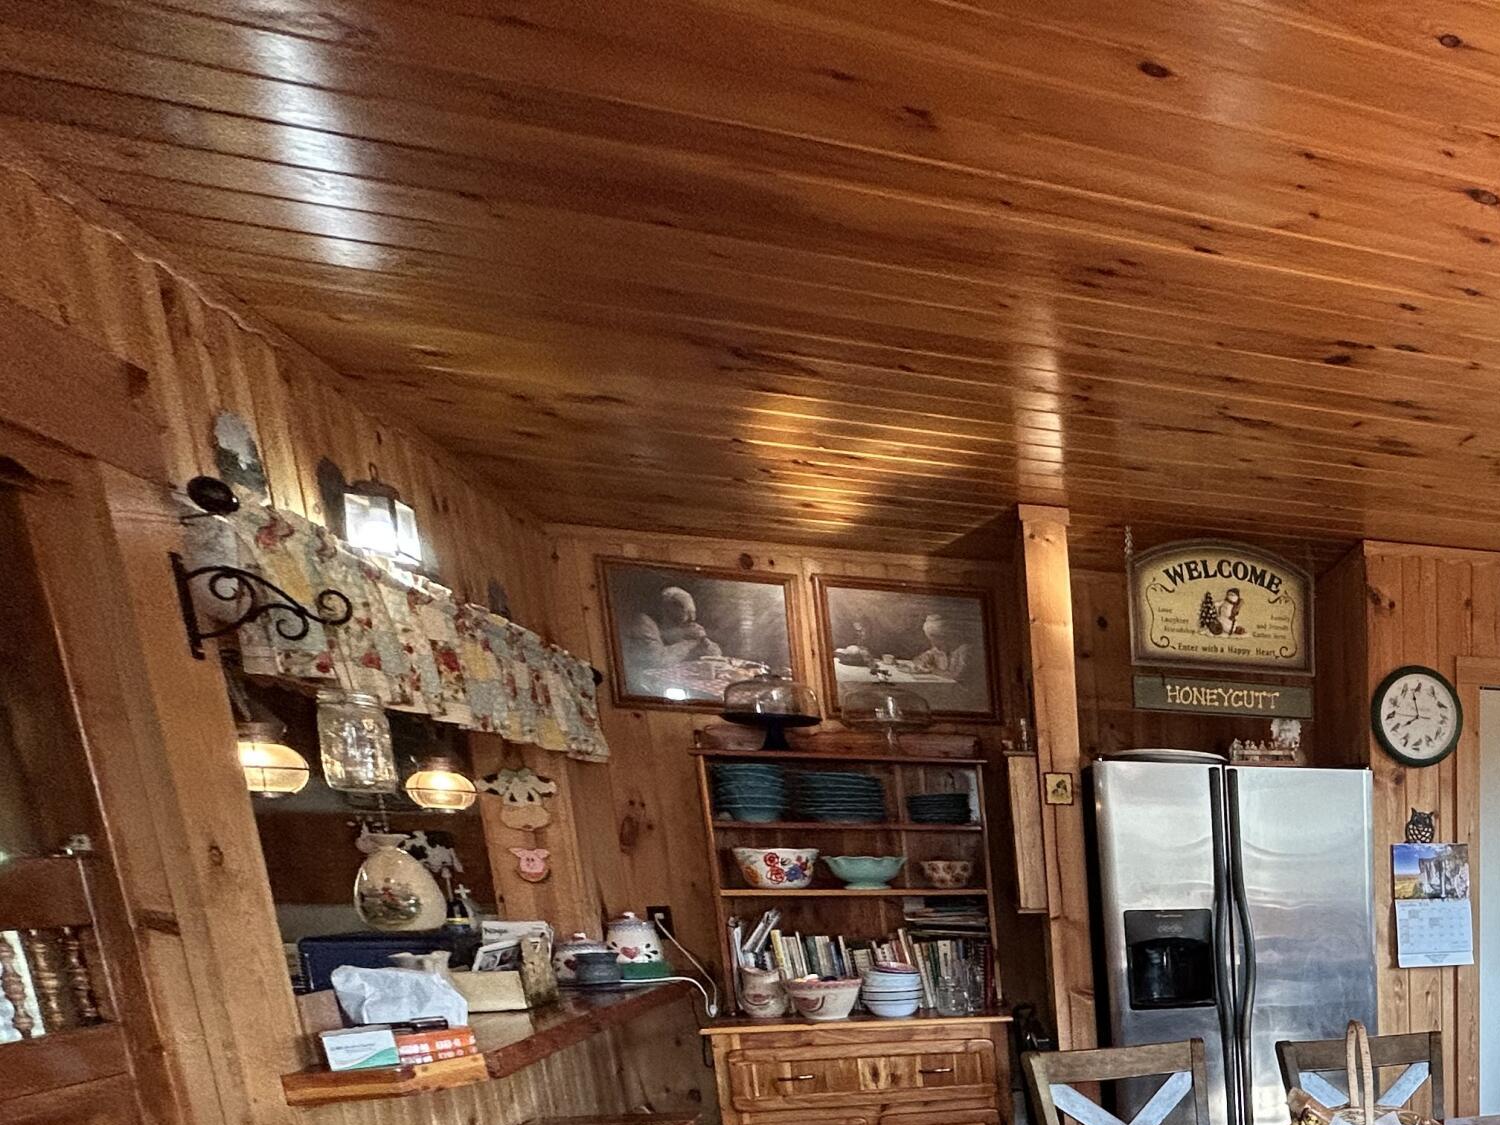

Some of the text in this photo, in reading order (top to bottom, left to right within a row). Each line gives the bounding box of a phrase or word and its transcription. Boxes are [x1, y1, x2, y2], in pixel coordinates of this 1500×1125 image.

[1162, 559, 1283, 595] WELCOME
[1178, 642, 1198, 653] Enter
[1202, 644, 1218, 654] with
[1228, 644, 1251, 656] Happy
[1256, 647, 1276, 657] Heart
[1166, 684, 1280, 709] HONEYCUTT
